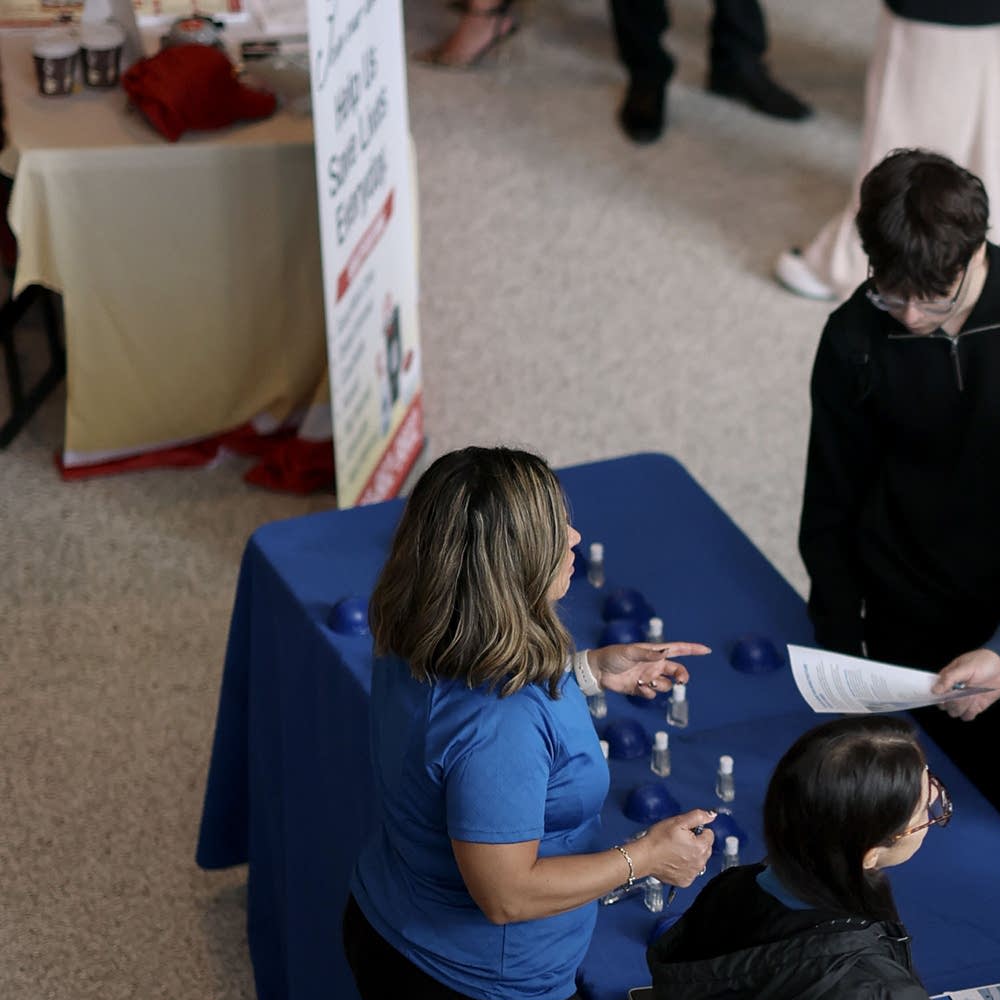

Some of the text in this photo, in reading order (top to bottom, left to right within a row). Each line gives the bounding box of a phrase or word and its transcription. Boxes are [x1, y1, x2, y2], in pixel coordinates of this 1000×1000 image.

[334, 47, 378, 131] Help Us
[328, 86, 388, 197] Save Lives
